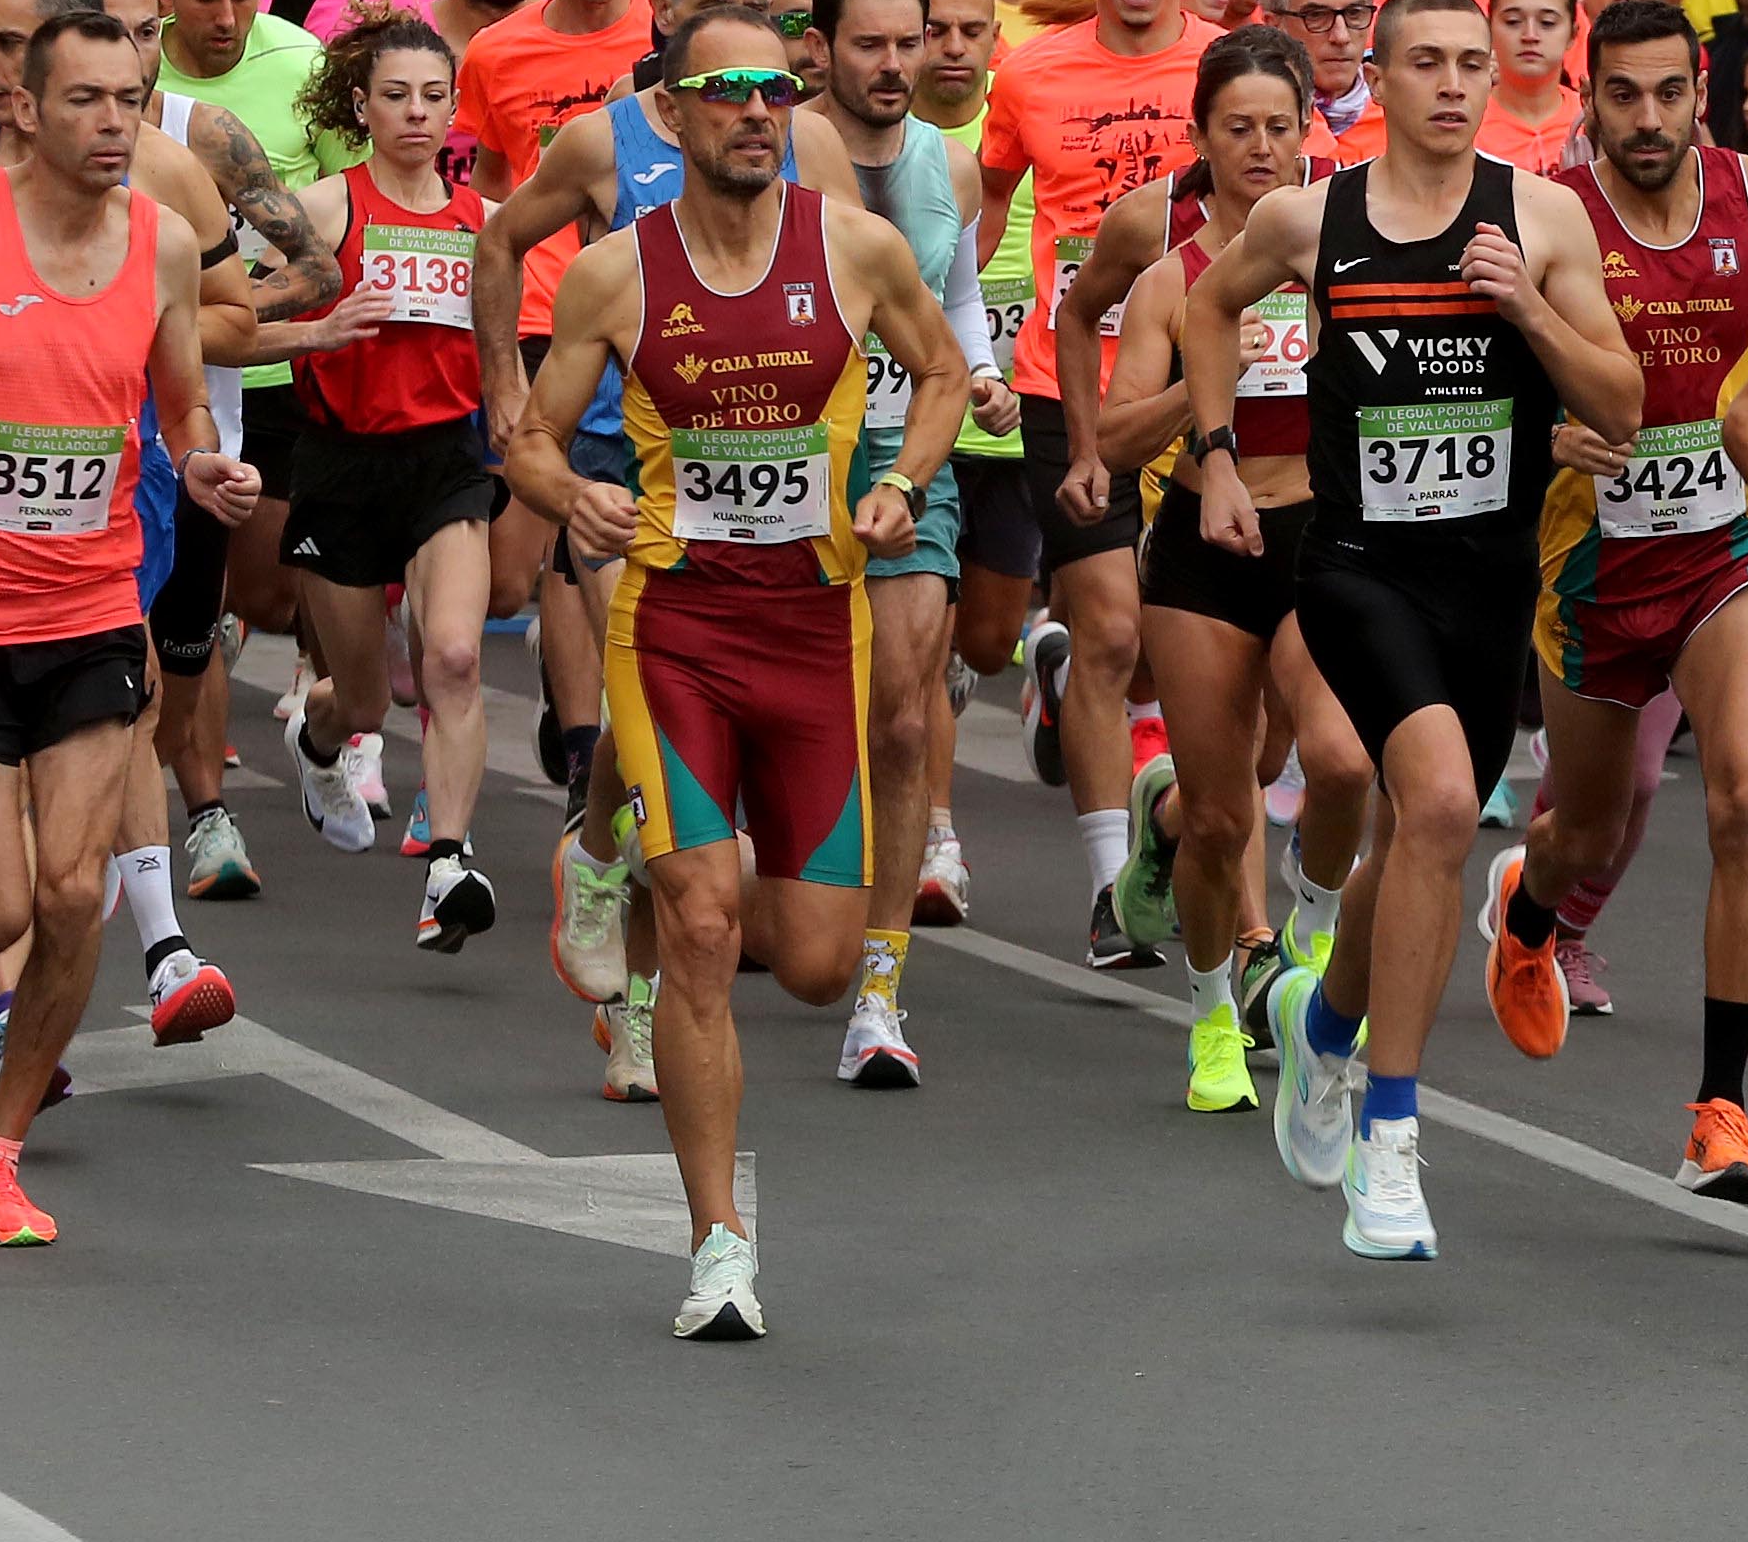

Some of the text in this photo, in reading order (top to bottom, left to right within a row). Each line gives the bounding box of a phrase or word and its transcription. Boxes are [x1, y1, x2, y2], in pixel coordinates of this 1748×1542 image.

[378, 227, 474, 244] XI LEGUA POPULAR
[389, 238, 470, 254] DE VALLADOLID
[371, 254, 471, 297] 3138
[409, 296, 440, 306] NOELIA
[1647, 298, 1734, 315] CAJA RURAL
[1646, 326, 1701, 347] VINO
[1406, 337, 1493, 359] VICKY
[1660, 346, 1722, 366] TORO
[711, 350, 814, 374] CAJA RURAL
[1418, 360, 1485, 375] FOODS
[711, 382, 778, 406] VINO
[1424, 386, 1483, 396] ATHLETICS
[691, 403, 801, 431] DE TORO
[1371, 404, 1495, 421] XI LEGUA POPULAR
[0, 424, 117, 440] XI LEGUA POPULAR
[1386, 417, 1494, 433] DE VALLADOLID
[12, 438, 109, 452] DE VALLADOLID
[686, 428, 814, 445] XI LEGUA POPULAR
[1640, 435, 1720, 453] VALLADOLID
[701, 442, 808, 457] DE VALLADOLID
[1367, 435, 1496, 485] 3718
[683, 459, 810, 508] 3495
[1603, 450, 1728, 504] 3424
[1419, 488, 1460, 501] PARRAS
[18, 506, 73, 517] FERNANDO
[712, 511, 786, 525] KUANTOKEDA
[1650, 505, 1688, 518] NACHO
